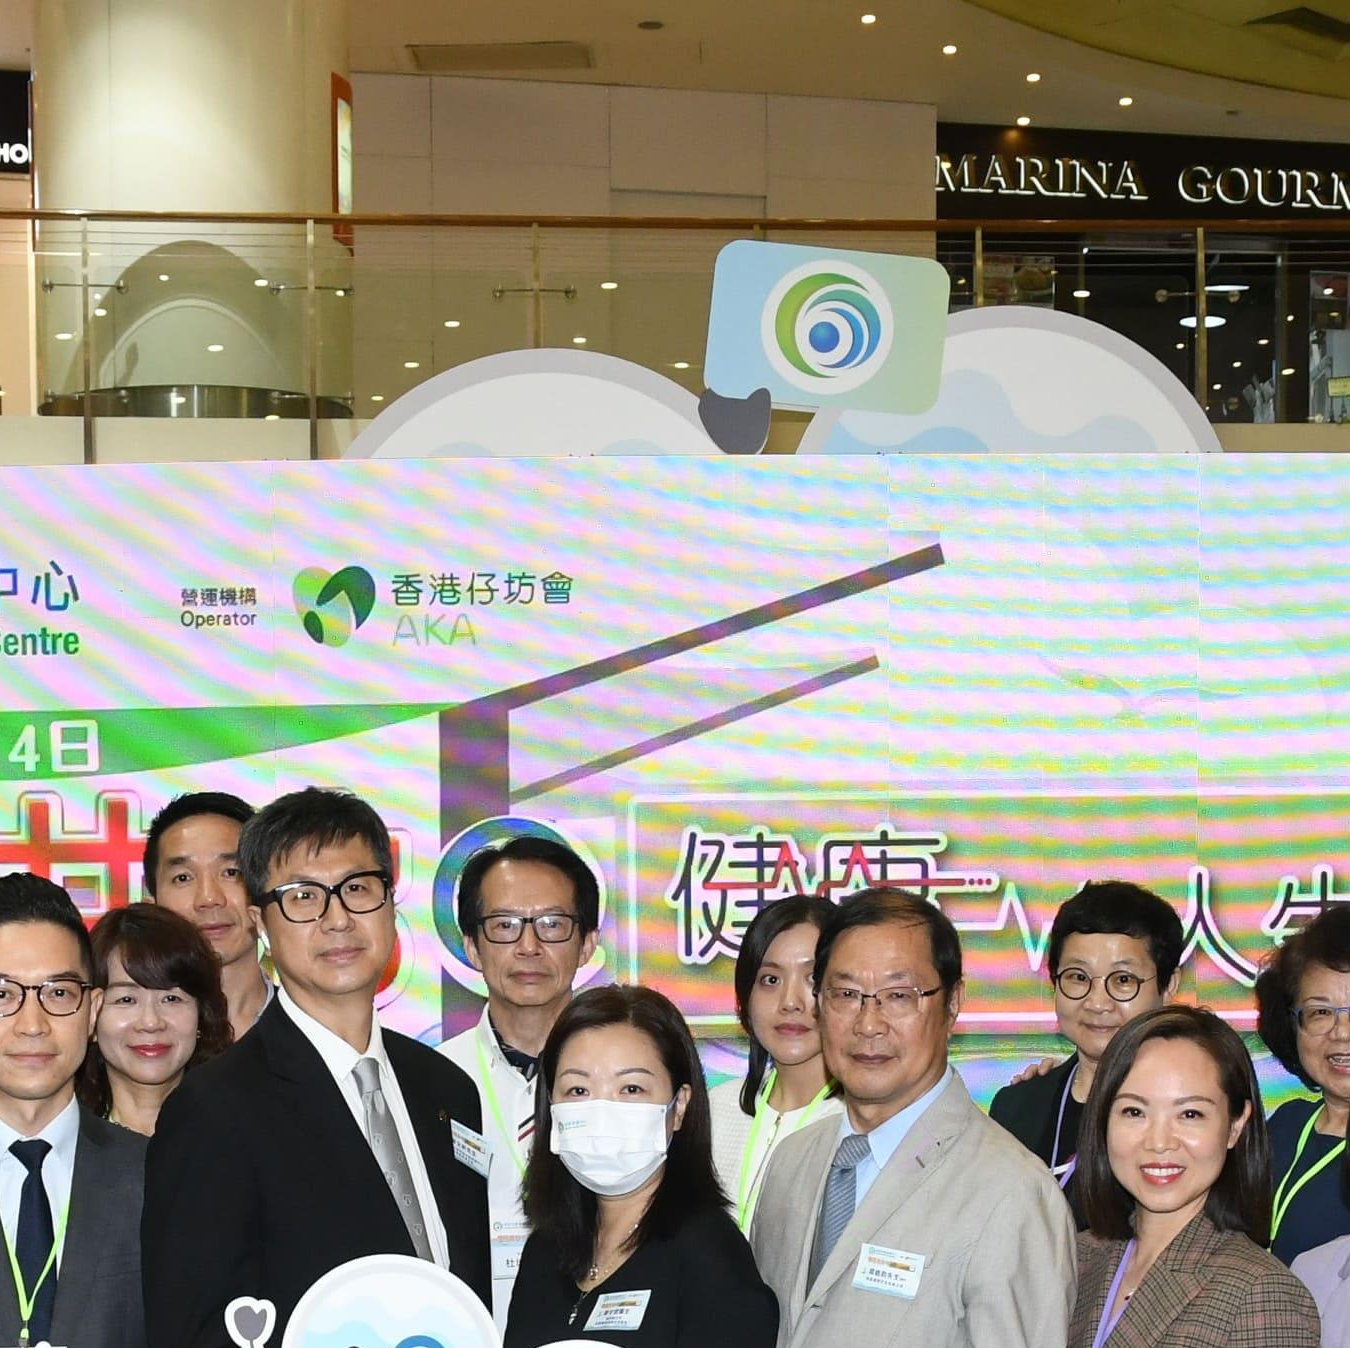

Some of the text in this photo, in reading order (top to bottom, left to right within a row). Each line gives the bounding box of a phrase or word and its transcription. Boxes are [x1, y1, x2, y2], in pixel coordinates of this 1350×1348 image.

[934, 155, 1149, 201] MARINA
[391, 571, 574, 606] 香港仔坊會
[180, 610, 257, 628] Operator
[391, 613, 477, 647] AKA
